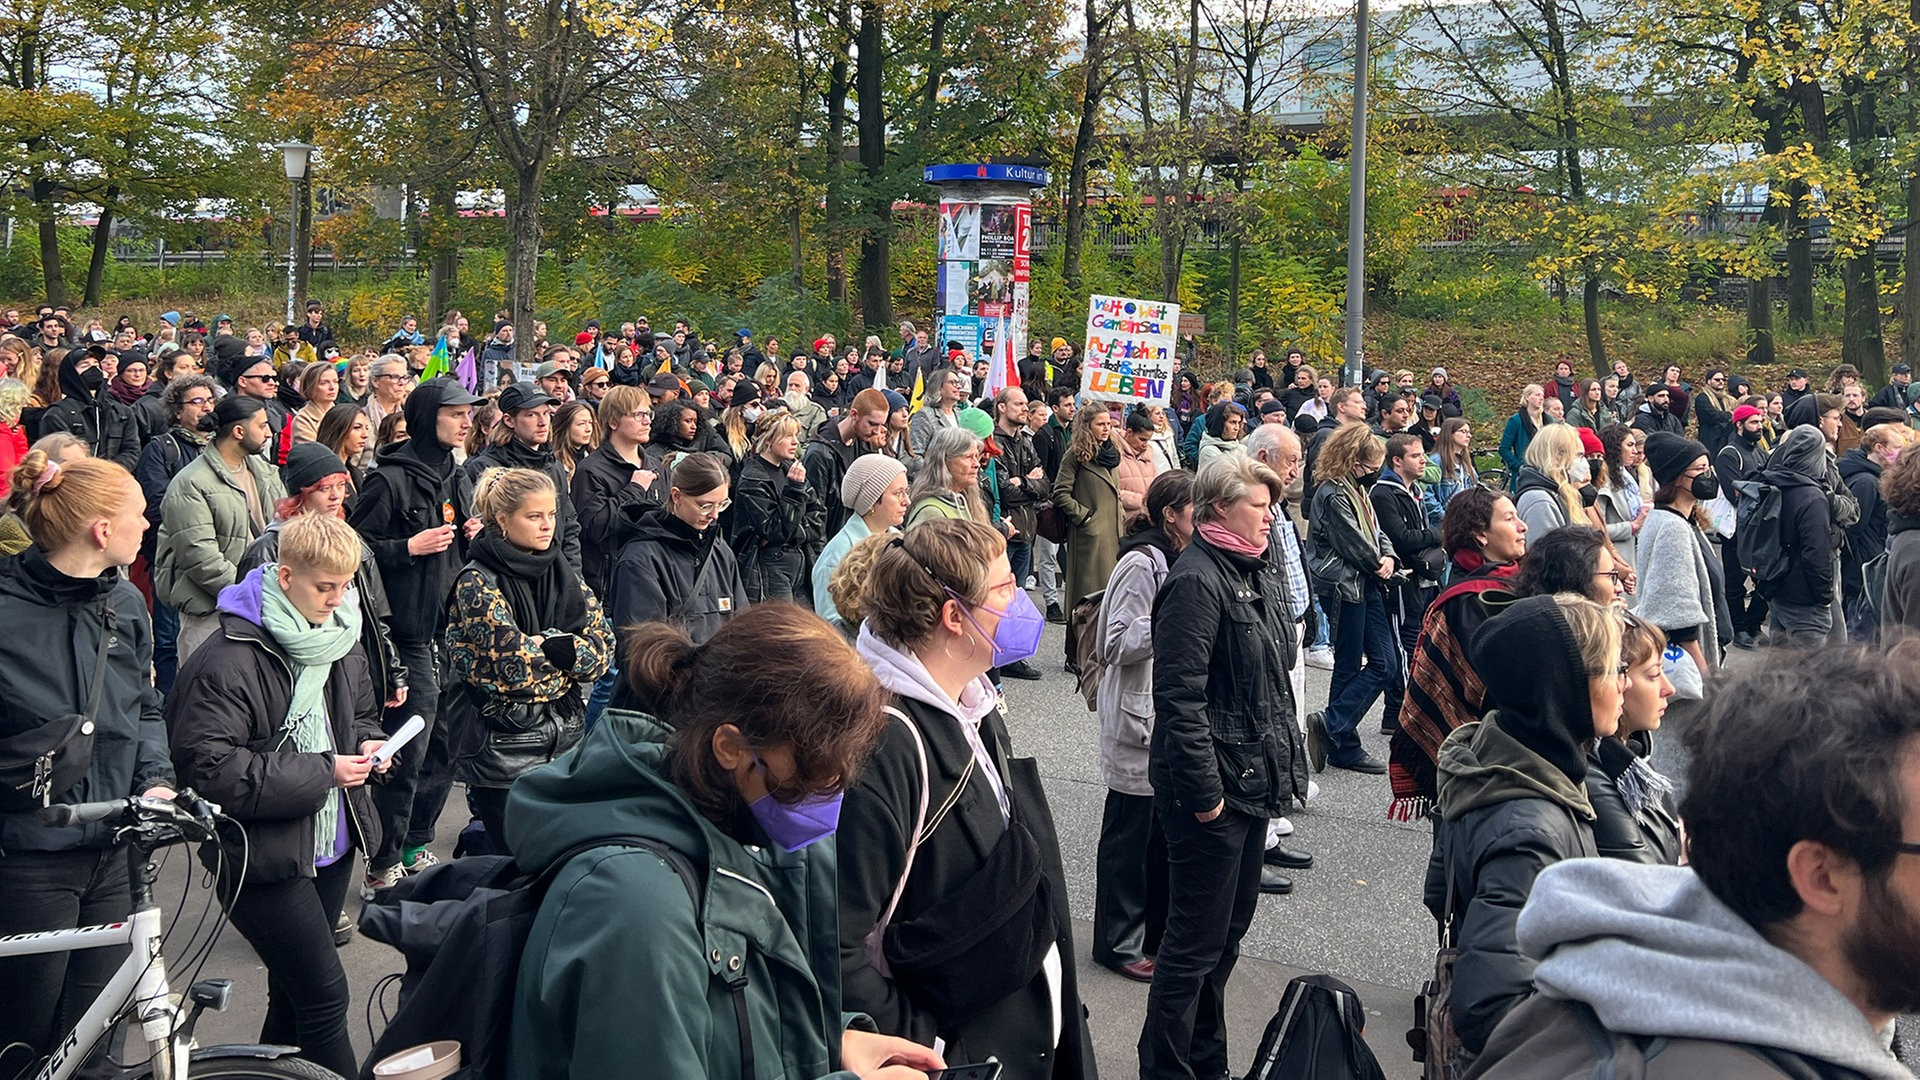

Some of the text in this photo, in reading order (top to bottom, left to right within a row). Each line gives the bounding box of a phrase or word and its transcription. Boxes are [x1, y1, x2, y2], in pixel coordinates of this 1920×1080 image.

[1006, 167, 1036, 180] Kultur
[1036, 171, 1043, 181] in
[1095, 299, 1167, 320] Welt Weit
[1089, 371, 1164, 399] LEBEN
